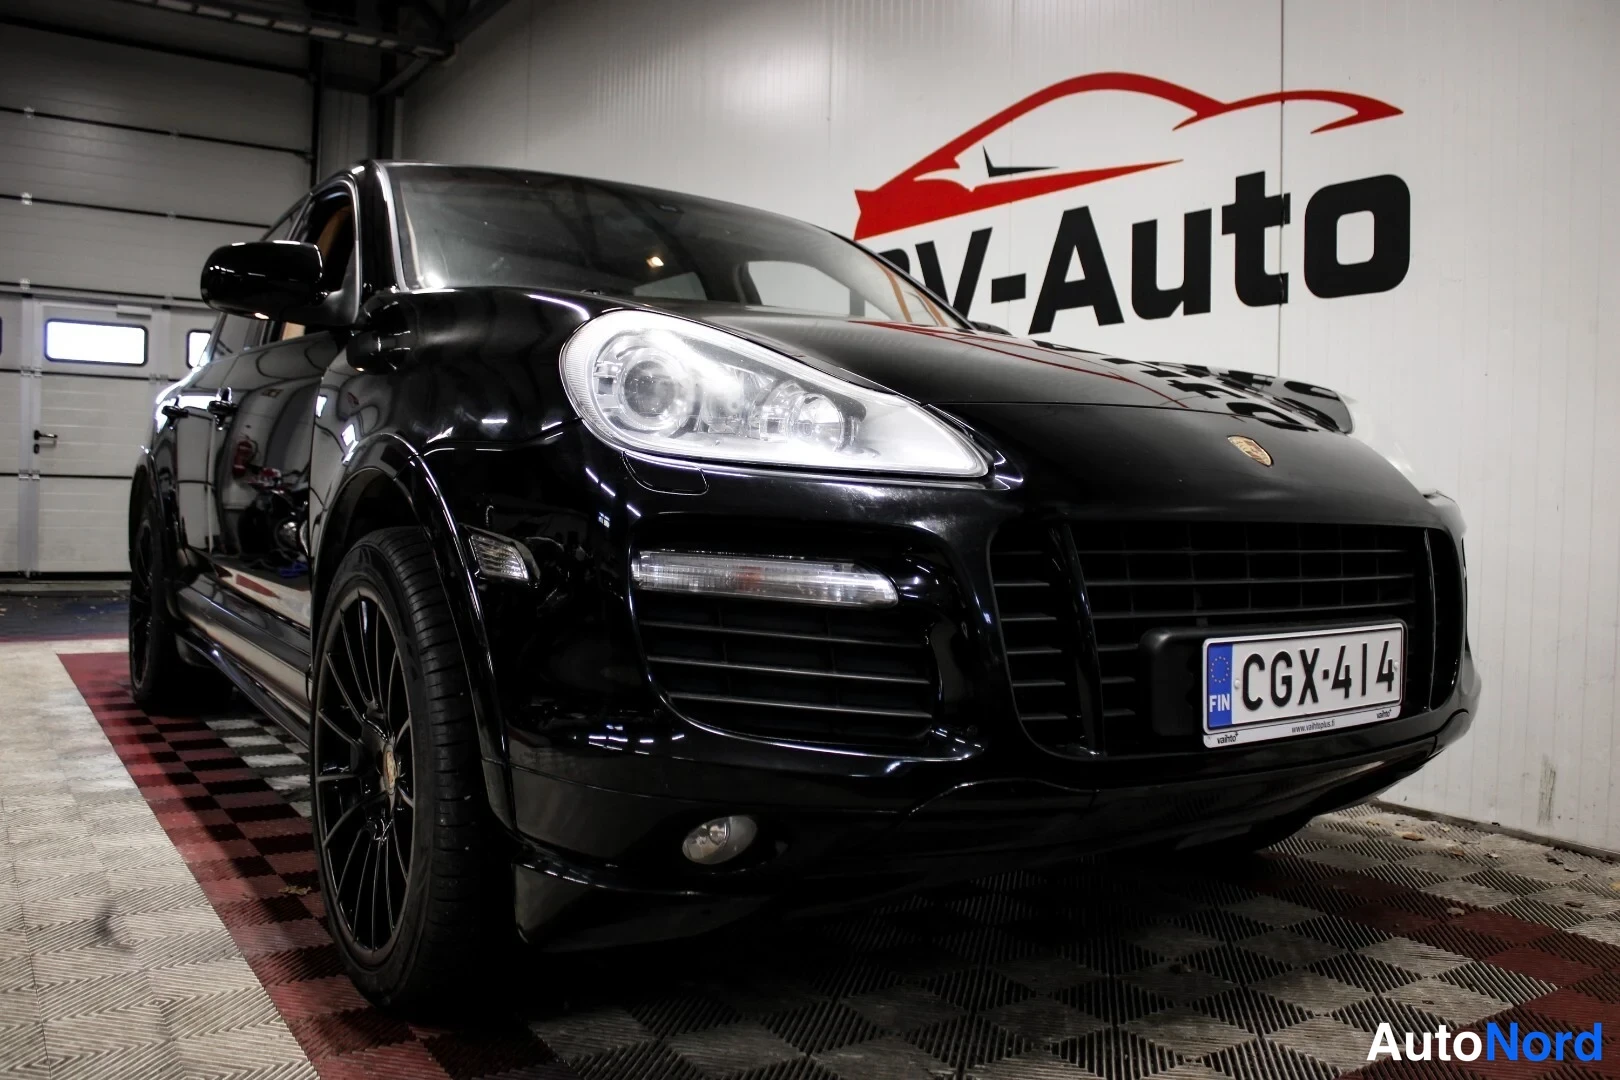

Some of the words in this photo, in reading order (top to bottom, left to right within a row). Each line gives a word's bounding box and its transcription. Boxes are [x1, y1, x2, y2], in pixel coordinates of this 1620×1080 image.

[1242, 641, 1394, 711] CGX-414
[1209, 693, 1231, 713] FIN
[1291, 719, 1335, 733] www.vaihtoplus.fi
